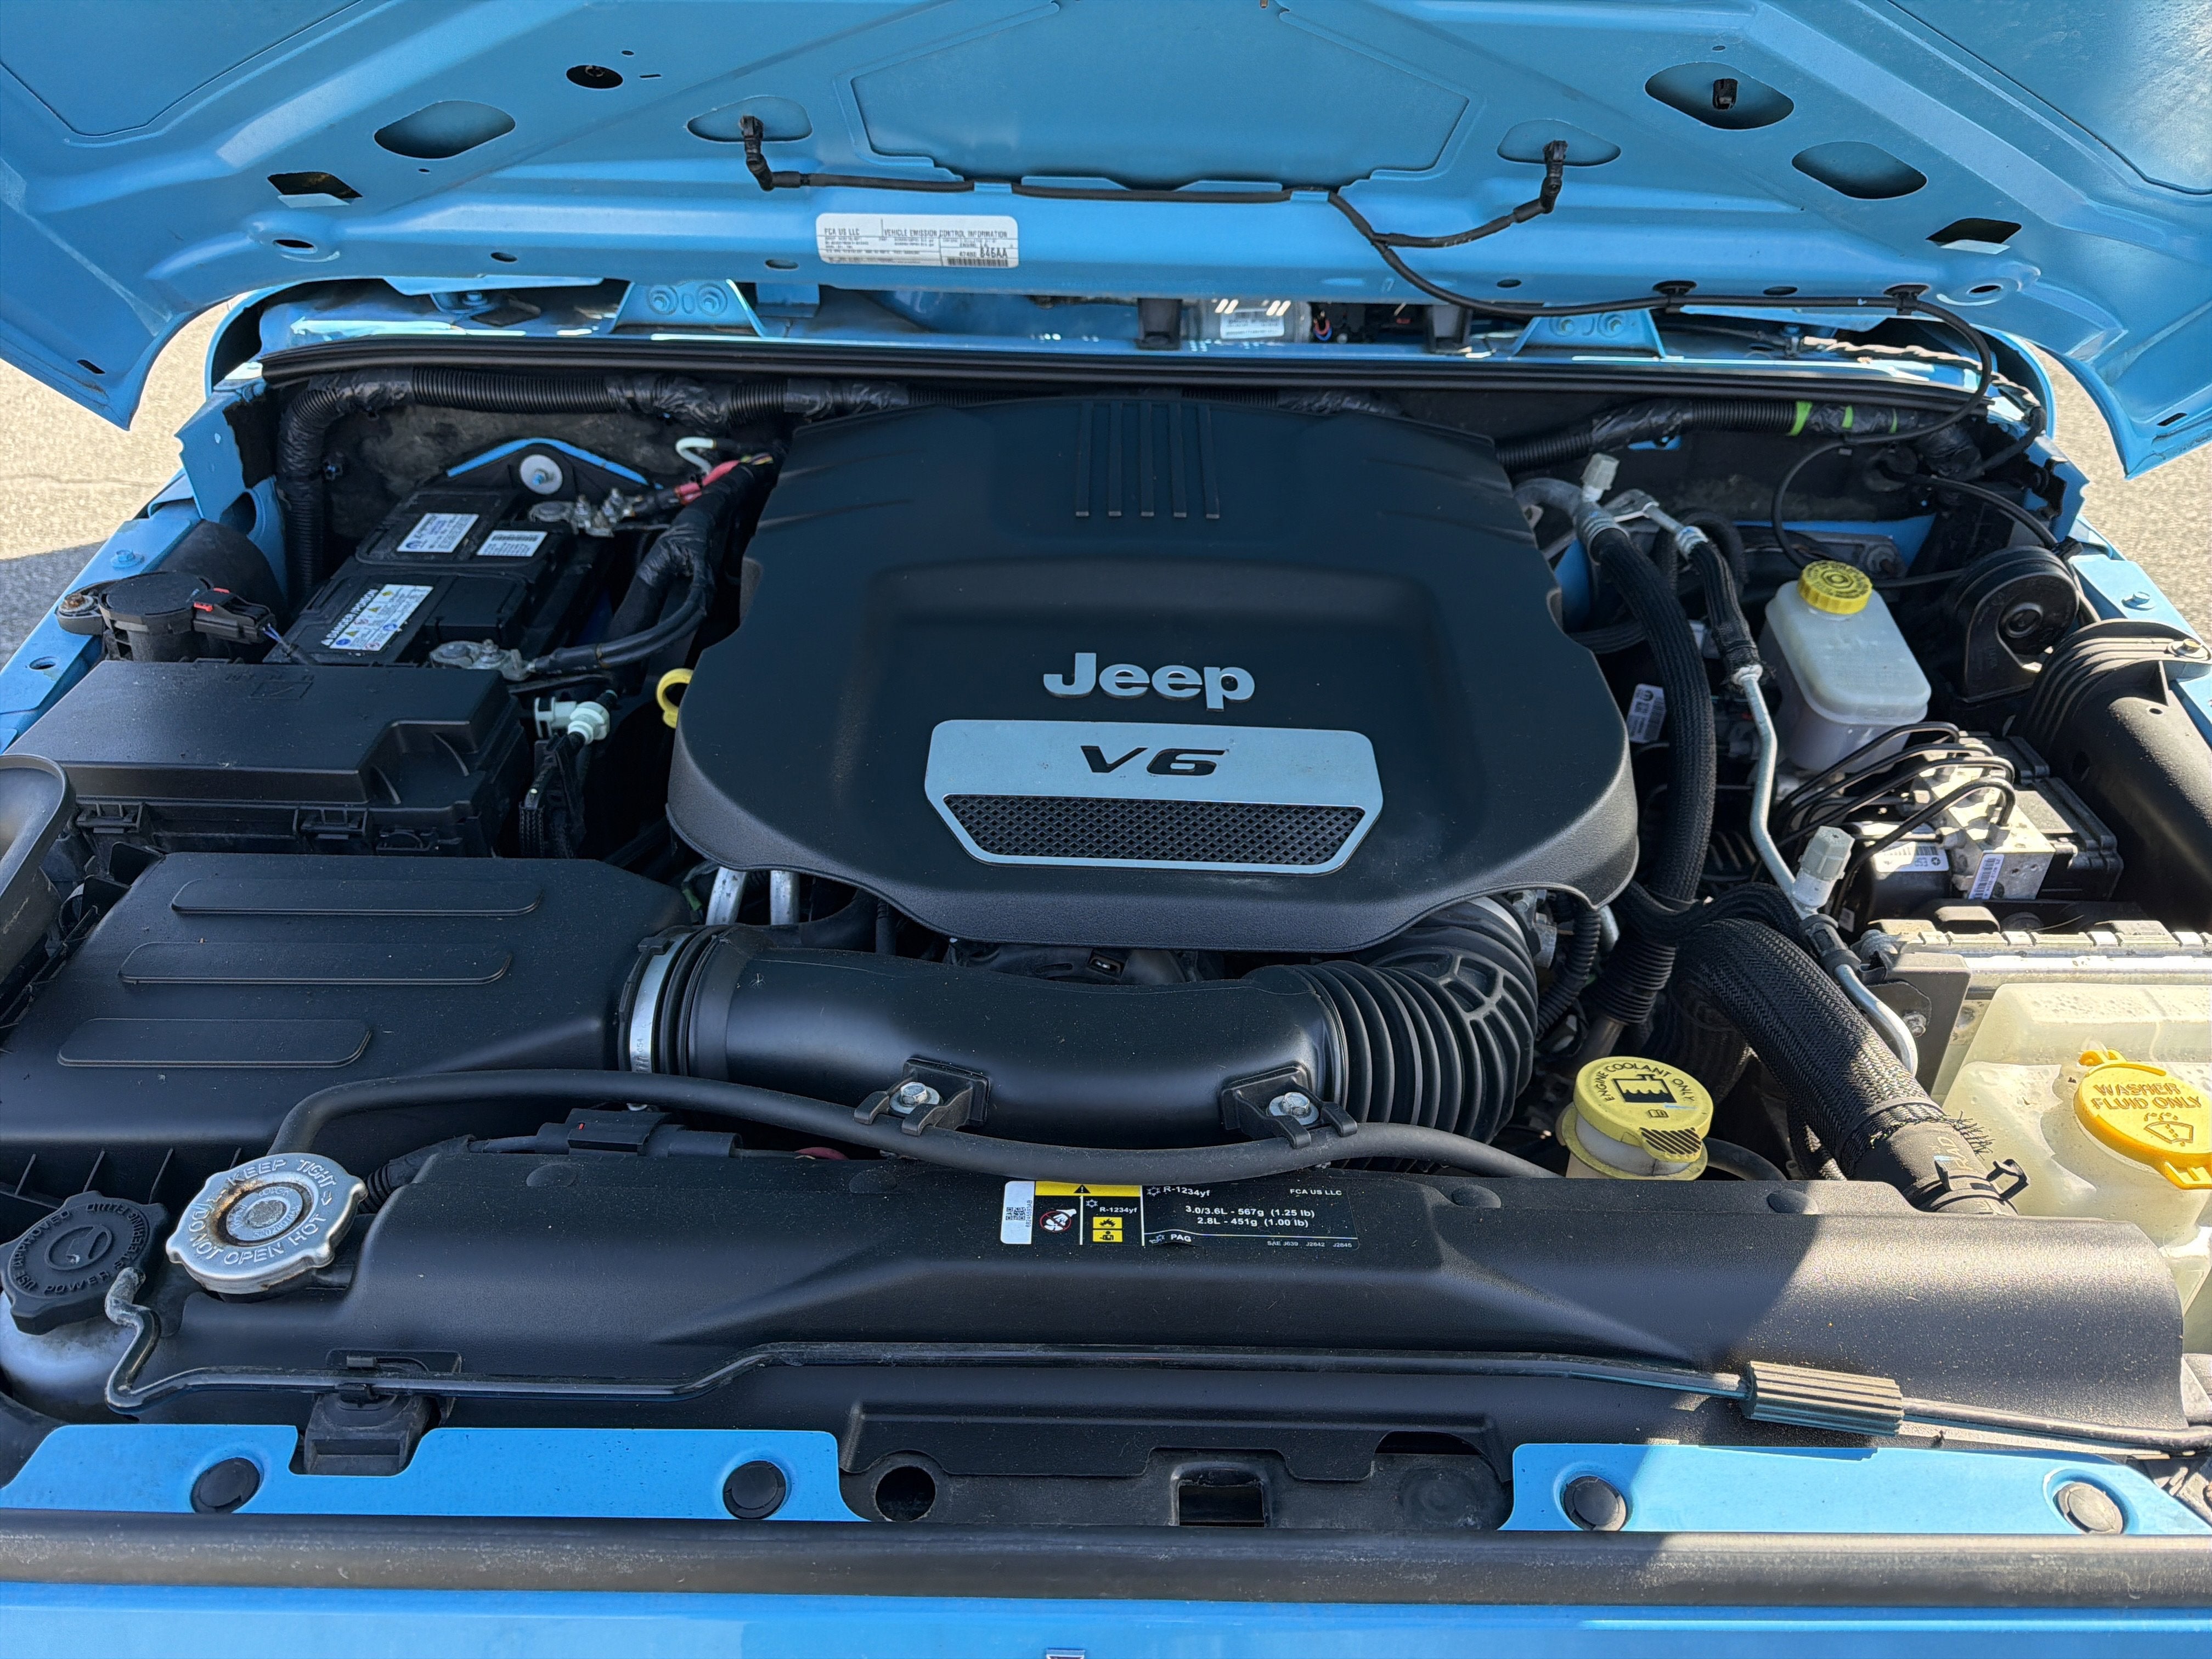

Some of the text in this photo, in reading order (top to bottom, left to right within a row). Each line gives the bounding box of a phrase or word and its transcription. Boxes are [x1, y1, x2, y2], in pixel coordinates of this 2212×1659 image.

[824, 228, 836, 236] FCA
[838, 228, 847, 236] US
[884, 228, 1008, 238] VEHICLE EMISSION CONTROL INFORMATION
[326, 613, 357, 639] DANGER
[1043, 652, 1256, 712] Jeep
[1080, 745, 1226, 776] V6
[1595, 1062, 1695, 1102] ENGINE COOLANT ONLY
[2092, 1082, 2181, 1096] WASHER
[2090, 1096, 2202, 1110] FLUID ONLY
[227, 1159, 337, 1188] KEEP TIGHT
[1163, 1186, 1211, 1198] R-1234yf
[1185, 1205, 1228, 1215] 3.0/3.6L
[1238, 1208, 1265, 1217] 567g
[1271, 1209, 1297, 1217] (1.25
[1300, 1210, 1315, 1218] lb)
[1231, 1218, 1257, 1227] 451g
[1264, 1218, 1291, 1227] (1.00
[1294, 1219, 1308, 1228] lb)
[190, 1233, 224, 1260] NOT
[223, 1242, 285, 1266] OPEN
[289, 1212, 326, 1246] HOT
[1170, 1234, 1192, 1242] PAG
[12, 1210, 71, 1267] APPROVED
[44, 1270, 111, 1296] POWER
[86, 1203, 129, 1216] FLUID
